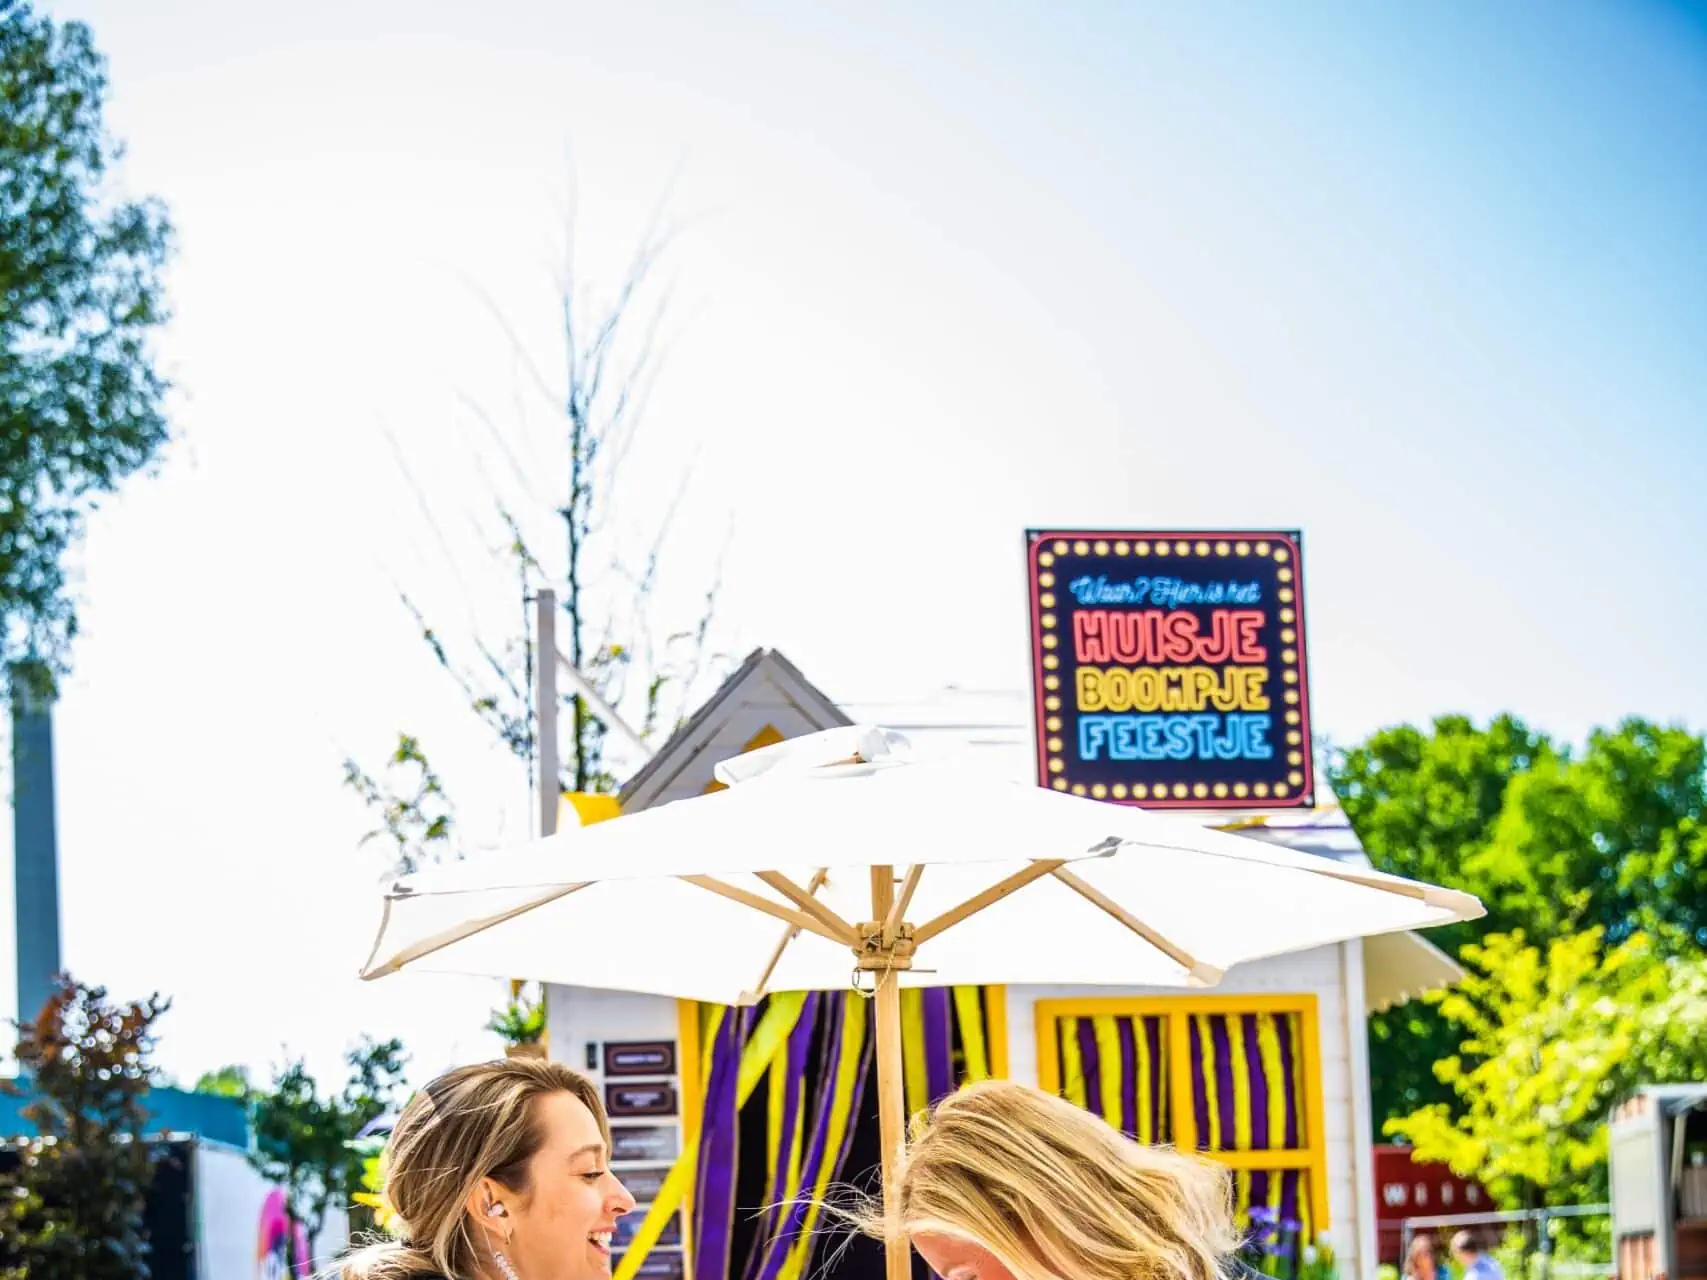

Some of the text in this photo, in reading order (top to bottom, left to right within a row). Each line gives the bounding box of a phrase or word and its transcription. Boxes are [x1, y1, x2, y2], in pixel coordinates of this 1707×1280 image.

[1073, 610, 1267, 663] HUISJE
[1076, 666, 1270, 712] BOOMPJE
[1078, 715, 1273, 760] FEESTJE
